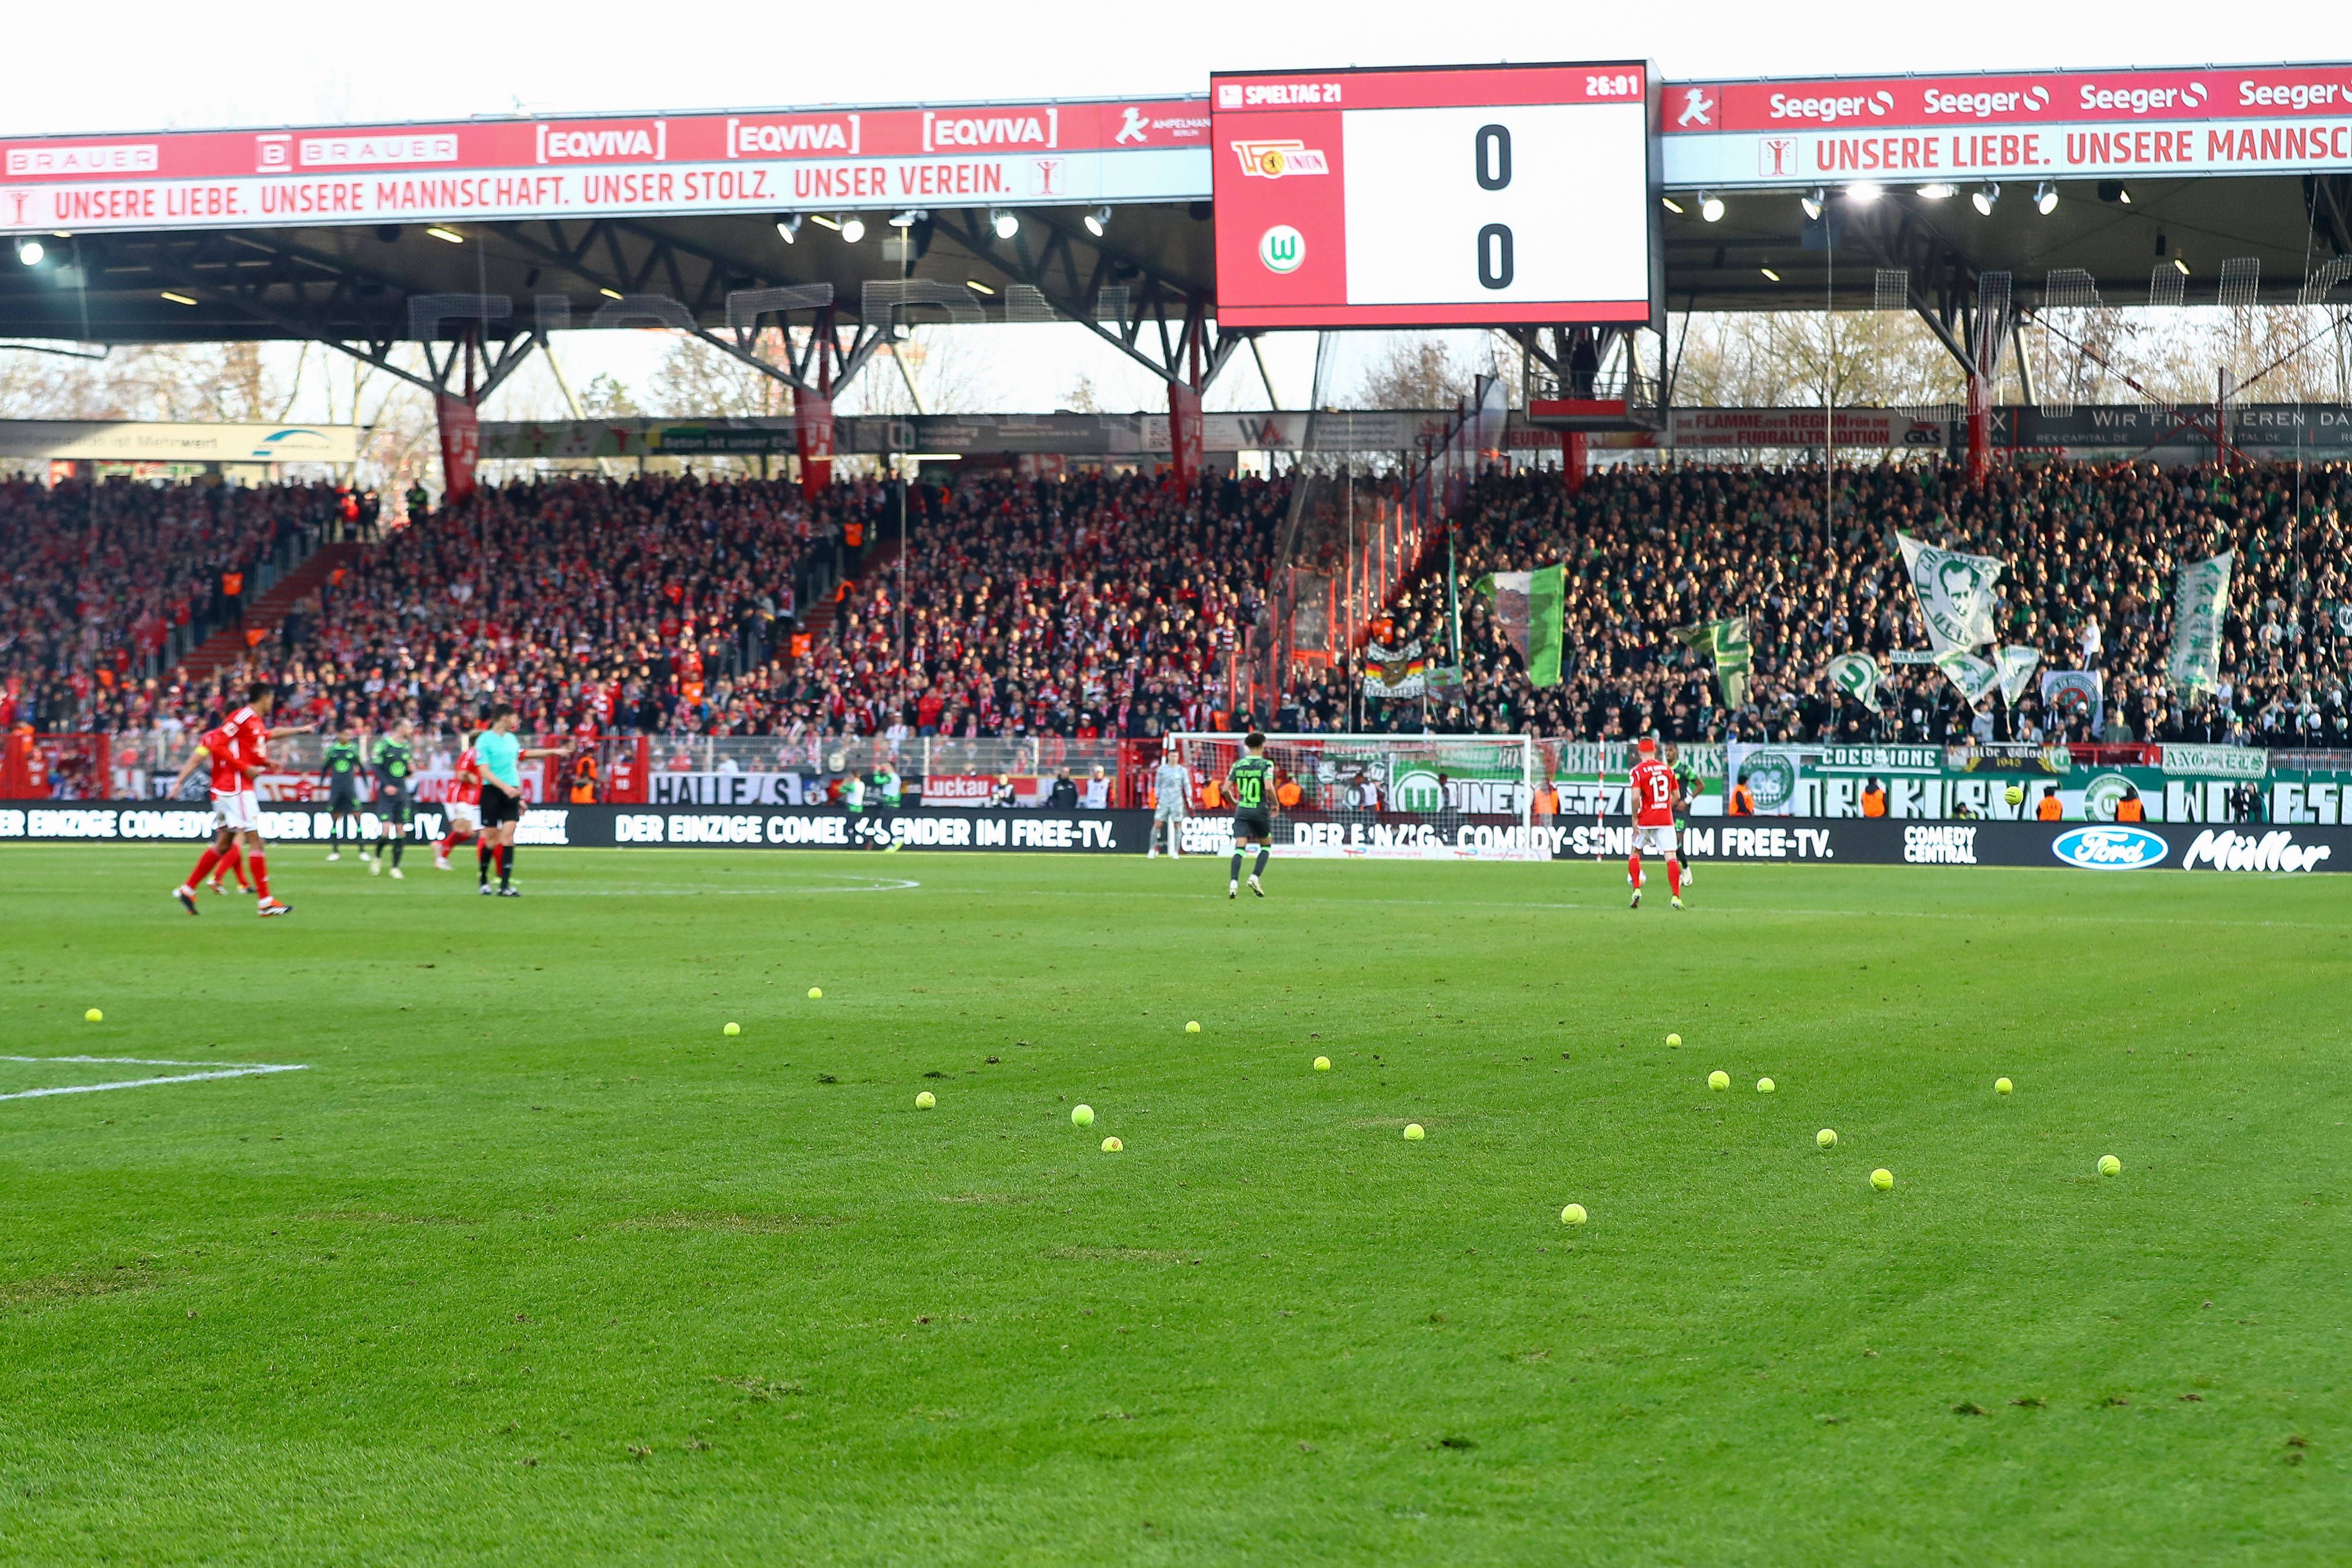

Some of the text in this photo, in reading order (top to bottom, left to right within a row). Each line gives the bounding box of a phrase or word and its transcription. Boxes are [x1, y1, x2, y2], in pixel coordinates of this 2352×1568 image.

[1245, 83, 1342, 105] SPIELTAG 21
[1585, 75, 1638, 96] 26:01
[2080, 83, 2177, 114] Seeger
[2239, 80, 2338, 110] Seeger
[1769, 92, 1866, 122] Seeger
[1923, 88, 2020, 118] Seeger
[1152, 118, 1211, 129] AMPELMAN
[12, 151, 154, 170] BRAUER
[306, 140, 452, 161] BRAUER
[1475, 124, 1511, 190] 0
[1816, 126, 2352, 170] UNSERE LIEBE. UNSERE MANNSC
[56, 163, 1011, 219] UNSERE LIEBE. UNSERE MANNSCHAFT. UNSER STOLZ. UNSER VEREIN.
[1271, 236, 1295, 260] W
[1478, 223, 1514, 289] 0
[1695, 414, 1763, 429] FLAMME
[2150, 412, 2306, 427] FINANEREN
[924, 777, 990, 797] Luckau
[1236, 777, 1261, 803] 40
[1649, 775, 1669, 803] 13
[0, 809, 26, 837] ER
[615, 814, 664, 842] DER
[668, 814, 763, 843] EINZIGE
[976, 818, 1007, 846] IM
[1011, 818, 1117, 848] FREE-TV.
[1904, 825, 1977, 845] COMEDY
[1294, 822, 1345, 847] DER
[1683, 827, 1715, 857] IM
[1722, 828, 1835, 859] FREE-TV.
[1904, 844, 1977, 864] CENTRAL
[2074, 831, 2147, 864] Ford
[2181, 829, 2331, 872] Müller
